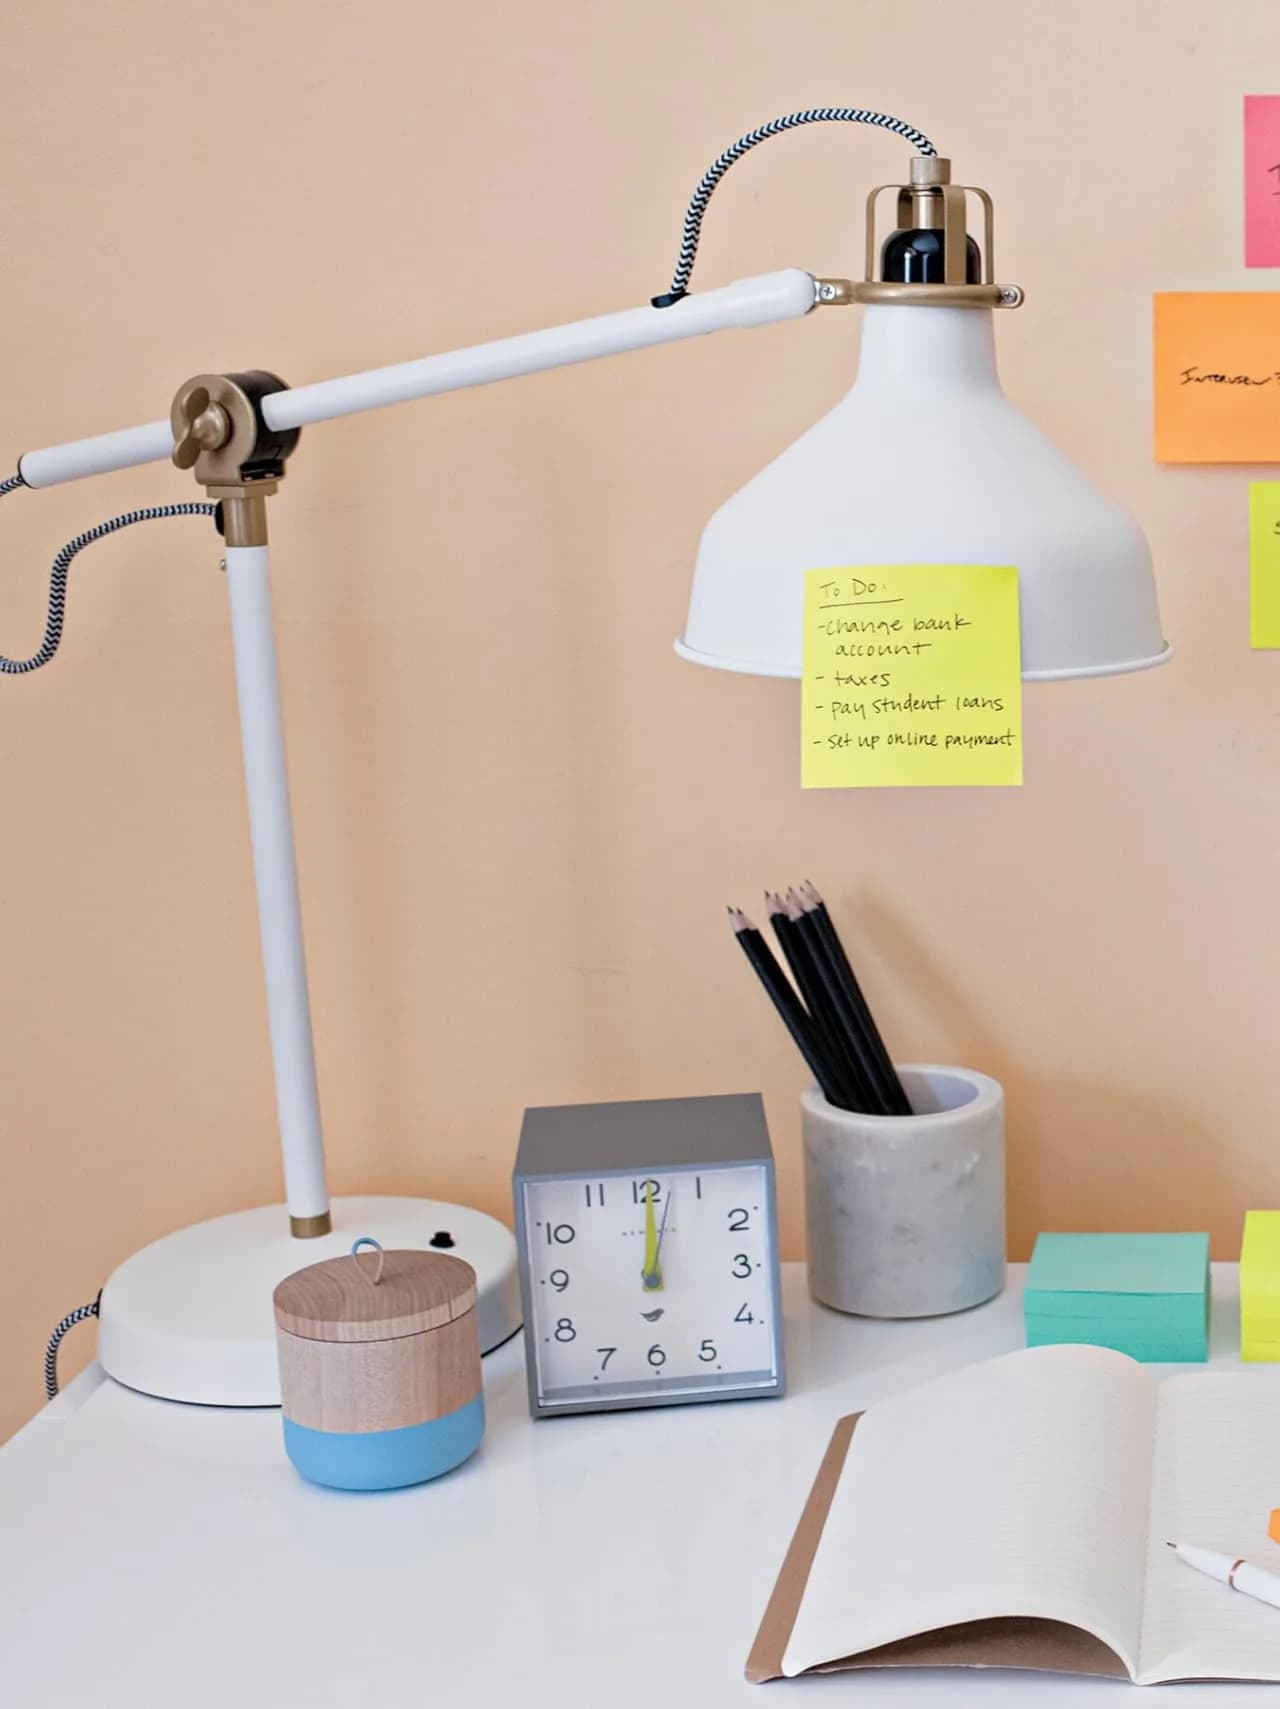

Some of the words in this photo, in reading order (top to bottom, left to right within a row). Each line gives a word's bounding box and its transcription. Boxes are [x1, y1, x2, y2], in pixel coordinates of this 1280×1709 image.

[819, 581, 840, 598] To
[914, 613, 972, 631] bank
[835, 642, 932, 656] account
[834, 671, 891, 687] taxes
[832, 701, 866, 720] pay
[872, 693, 946, 714] student
[956, 697, 1004, 711] loans
[828, 733, 853, 749] set
[858, 736, 880, 750] up
[888, 732, 938, 746] online
[945, 728, 1016, 749] payment
[585, 1183, 605, 1208] 11
[632, 1179, 662, 1204] 12
[695, 1175, 702, 1200] 1
[728, 1208, 750, 1232] 2
[546, 1222, 575, 1245] 10
[732, 1254, 752, 1279] 3
[549, 1269, 569, 1293] 9
[734, 1303, 754, 1324] 4
[554, 1318, 576, 1343] 8
[597, 1348, 617, 1371] 7
[647, 1344, 666, 1367] 6
[698, 1339, 717, 1362] 5
